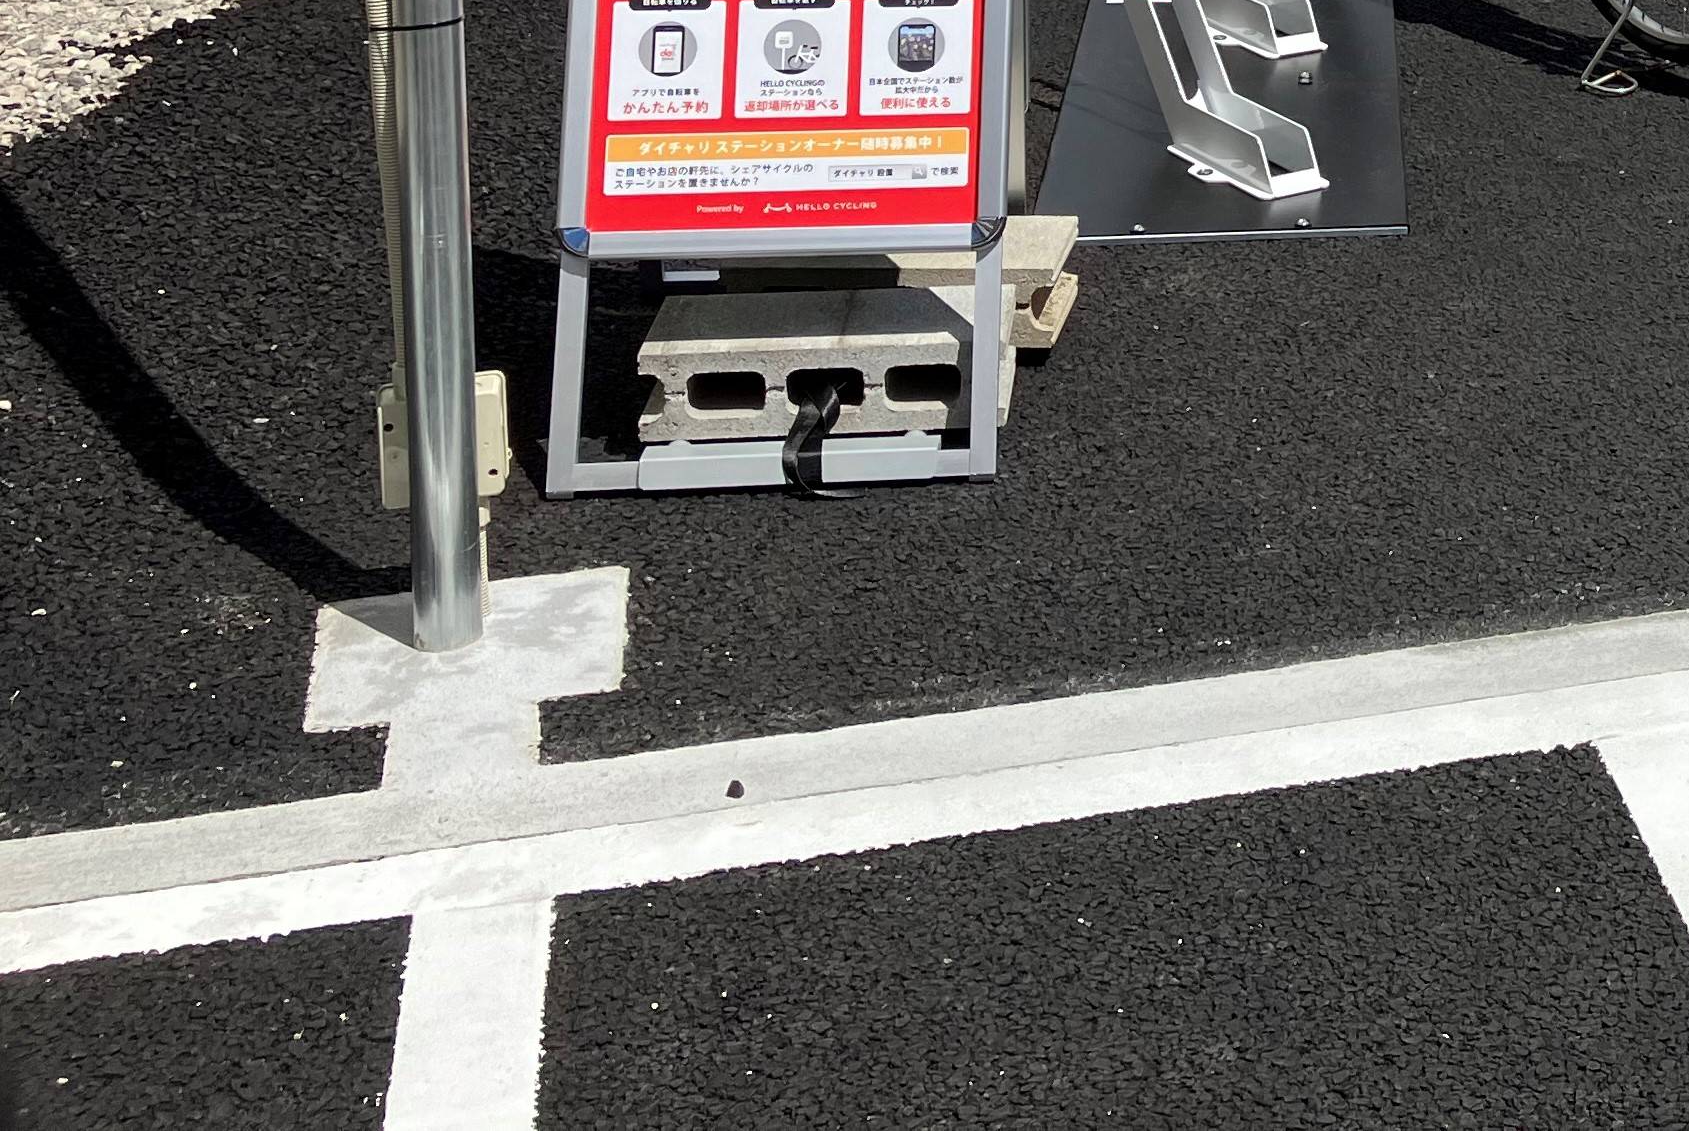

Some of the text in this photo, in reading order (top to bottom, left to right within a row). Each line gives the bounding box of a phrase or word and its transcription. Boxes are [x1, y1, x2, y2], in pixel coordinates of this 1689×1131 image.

[760, 79, 785, 87] HELLO
[631, 87, 700, 97] アプリで自転車を
[759, 88, 823, 97] ステーションなら
[622, 99, 710, 115] かんたん予約
[743, 98, 840, 113] 返却場所が選べる
[880, 96, 952, 110] 便利に使える
[639, 141, 710, 156] ダイチャリ
[833, 168, 893, 179] ダイチャリ 設置
[930, 166, 960, 176] で検索
[614, 176, 760, 190] ステーションを置きませんか？
[696, 204, 744, 214] Powered by
[795, 201, 878, 212] HELLO CYCLING
